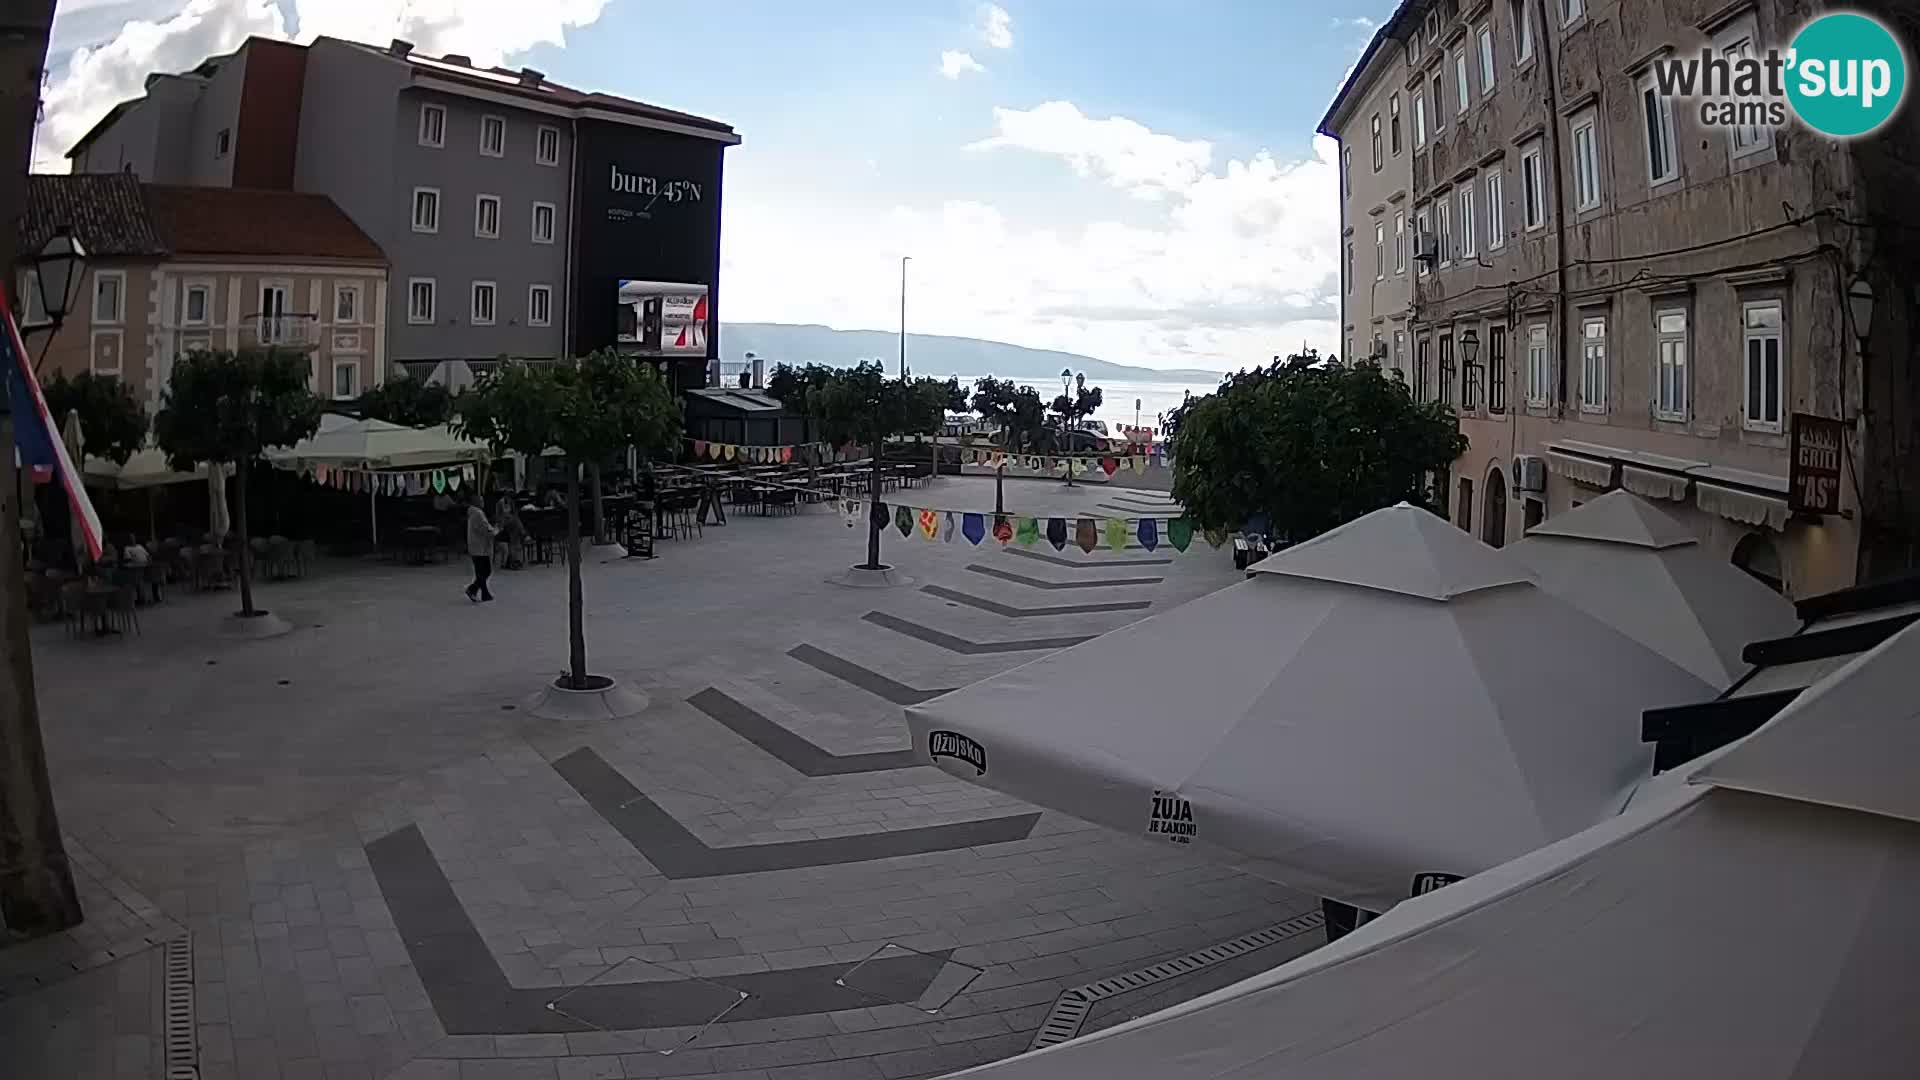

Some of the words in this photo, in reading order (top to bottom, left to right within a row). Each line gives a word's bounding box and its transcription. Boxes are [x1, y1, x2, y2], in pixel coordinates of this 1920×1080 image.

[611, 165, 657, 196] bura
[1151, 790, 1193, 822] ŽUJA
[1149, 820, 1159, 833] JE
